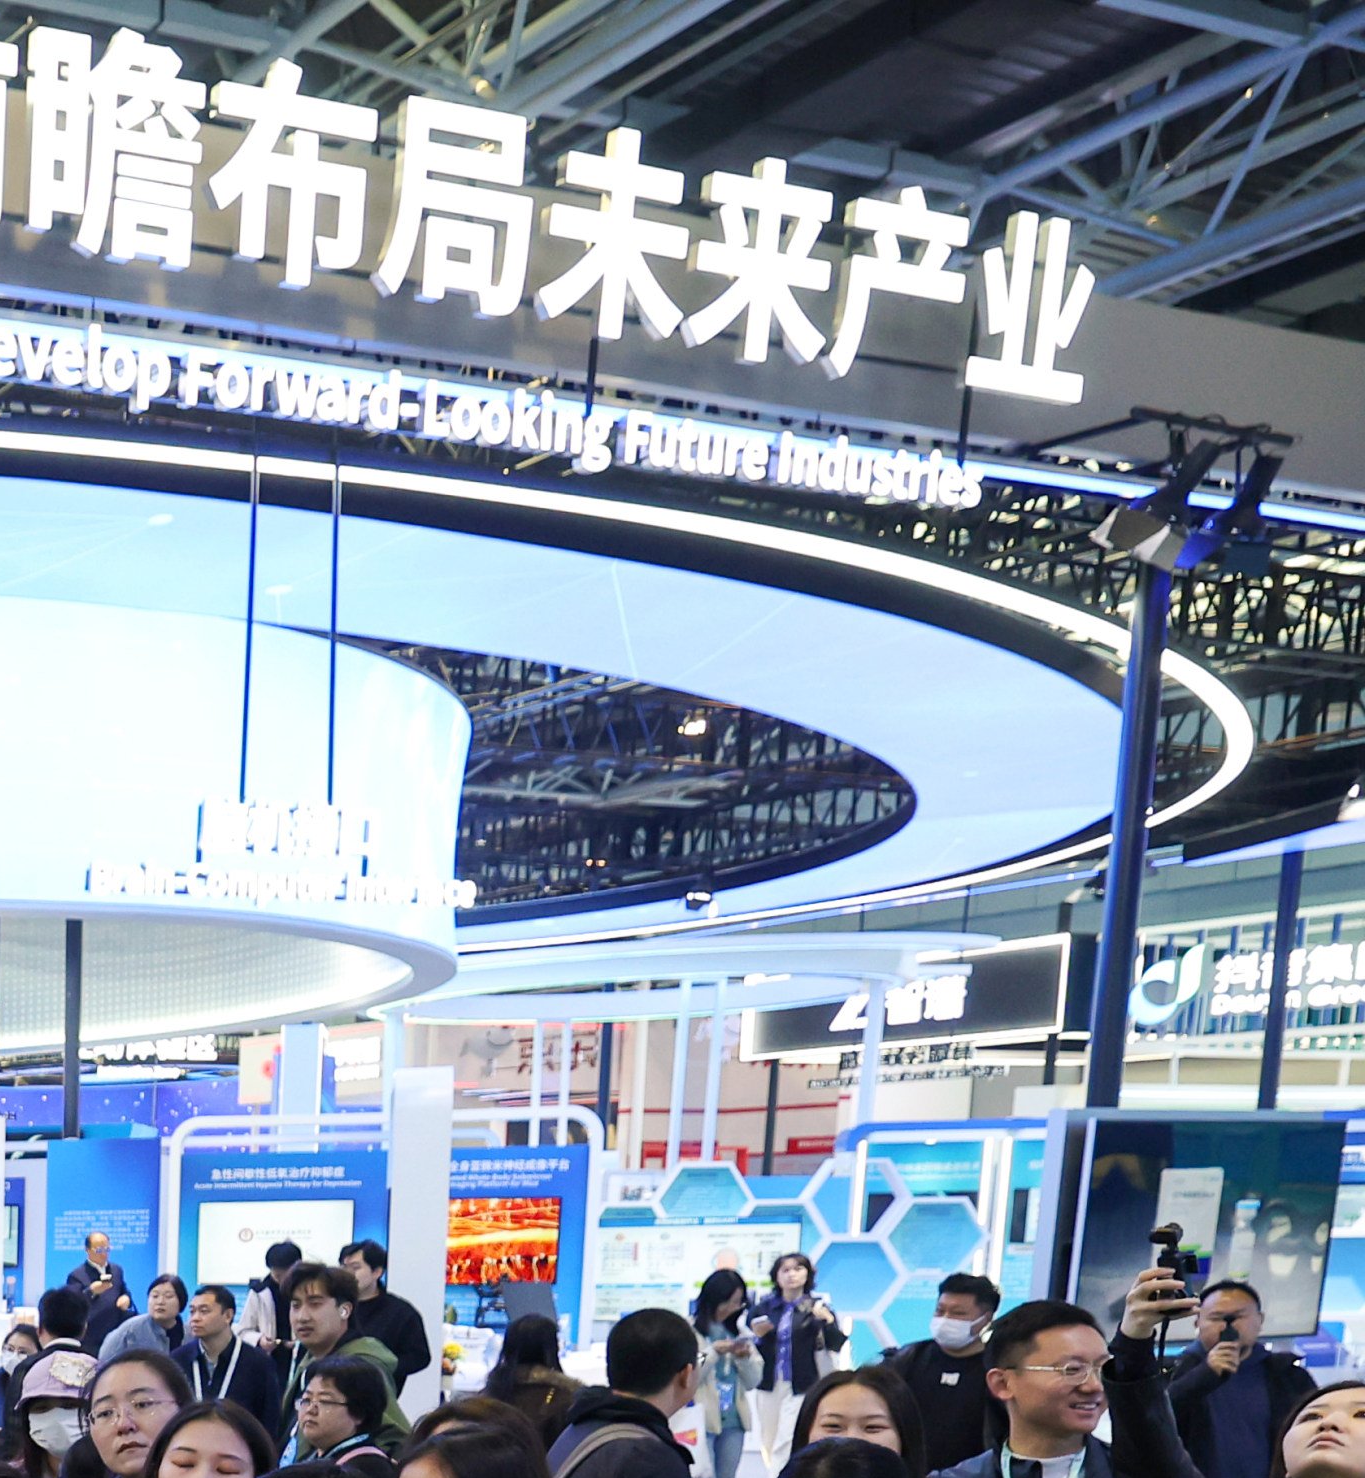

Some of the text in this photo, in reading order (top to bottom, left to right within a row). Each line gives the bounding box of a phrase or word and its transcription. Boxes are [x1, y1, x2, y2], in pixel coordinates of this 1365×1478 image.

[177, 345, 613, 474] Forward-Looking
[623, 409, 768, 481] Future
[775, 431, 984, 510] Industries
